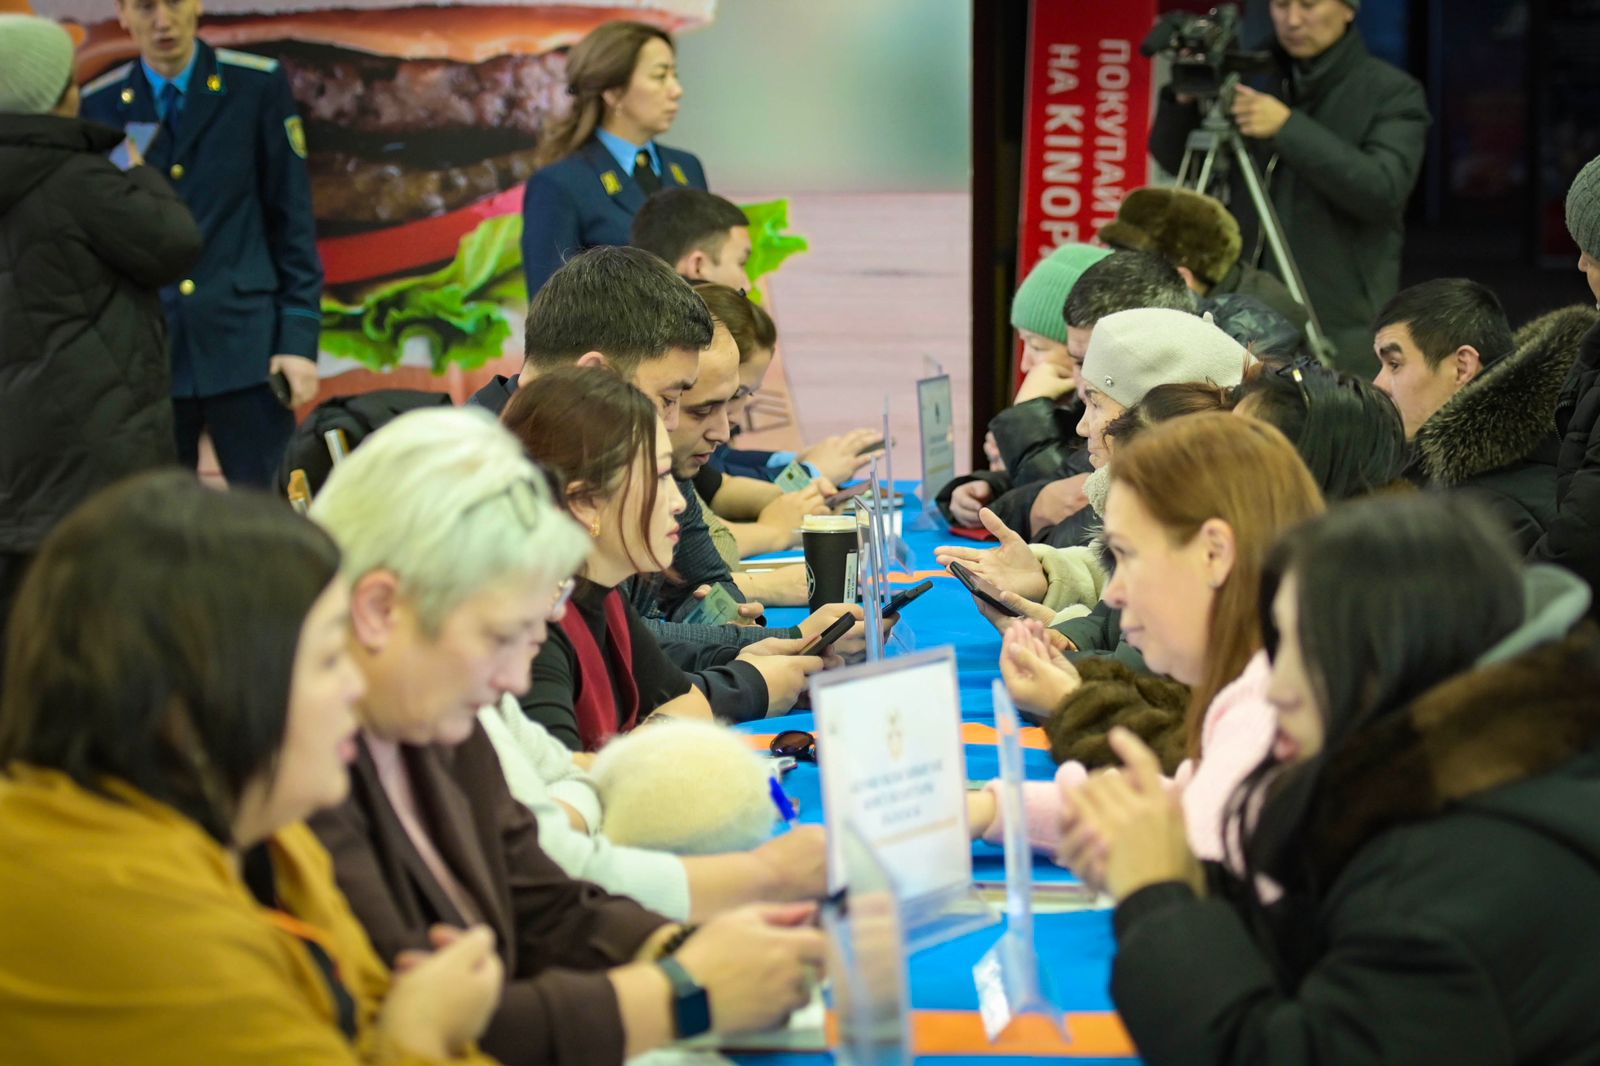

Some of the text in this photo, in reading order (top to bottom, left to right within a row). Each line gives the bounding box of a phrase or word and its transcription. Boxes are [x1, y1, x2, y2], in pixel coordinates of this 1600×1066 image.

[1038, 43, 1085, 259] НА KINOP
[1090, 38, 1132, 249] ПОКУПАЙ
